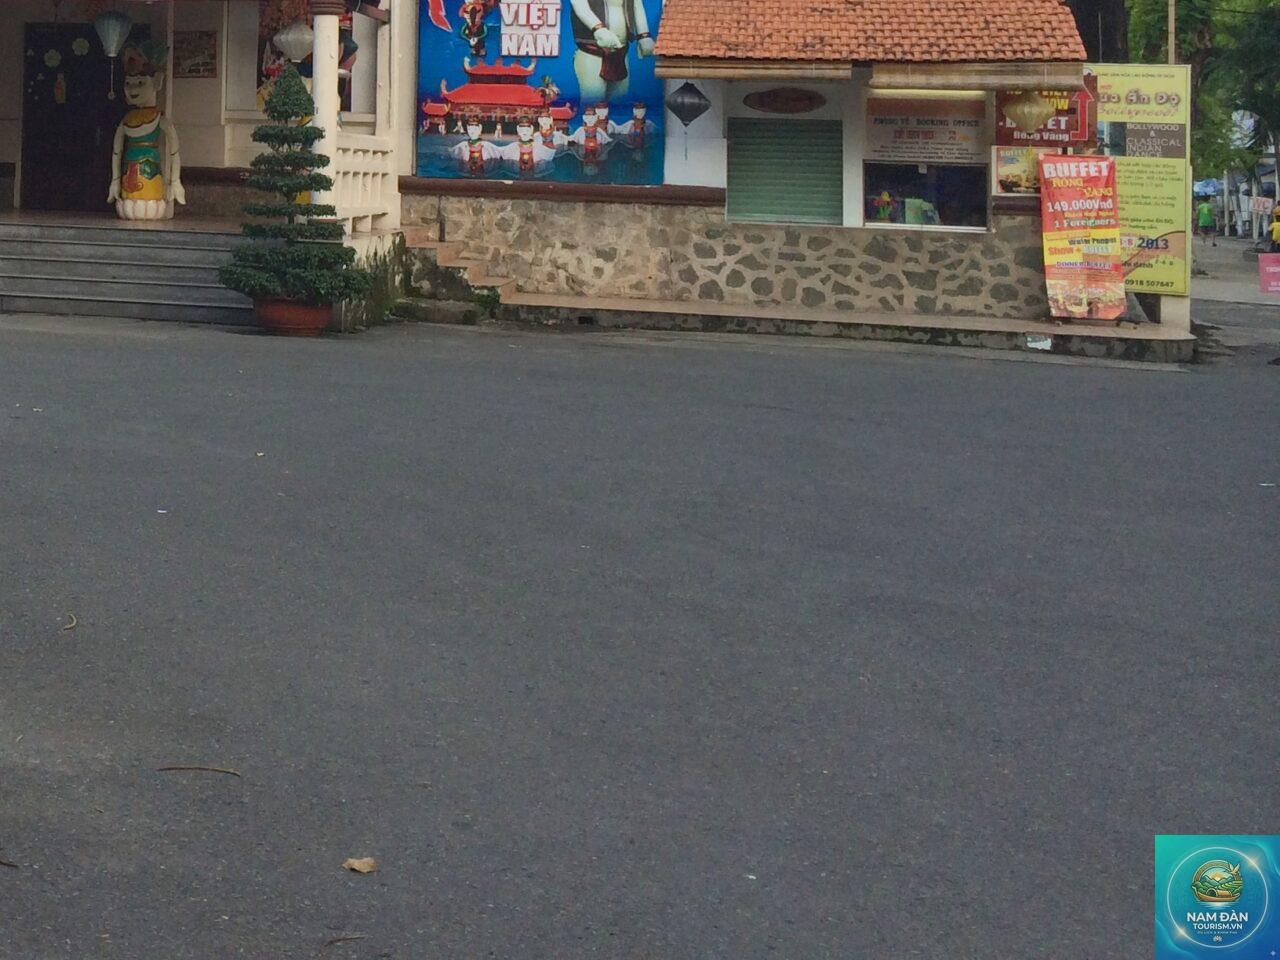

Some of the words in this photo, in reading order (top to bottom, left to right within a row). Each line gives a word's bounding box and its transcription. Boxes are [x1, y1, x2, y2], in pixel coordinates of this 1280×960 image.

[499, 0, 561, 31] VIỆT
[501, 34, 559, 57] NAM
[1126, 123, 1180, 131] BOLLYWOOD
[1126, 137, 1183, 147] CLASSICAL
[1043, 161, 1110, 179] BUFFET
